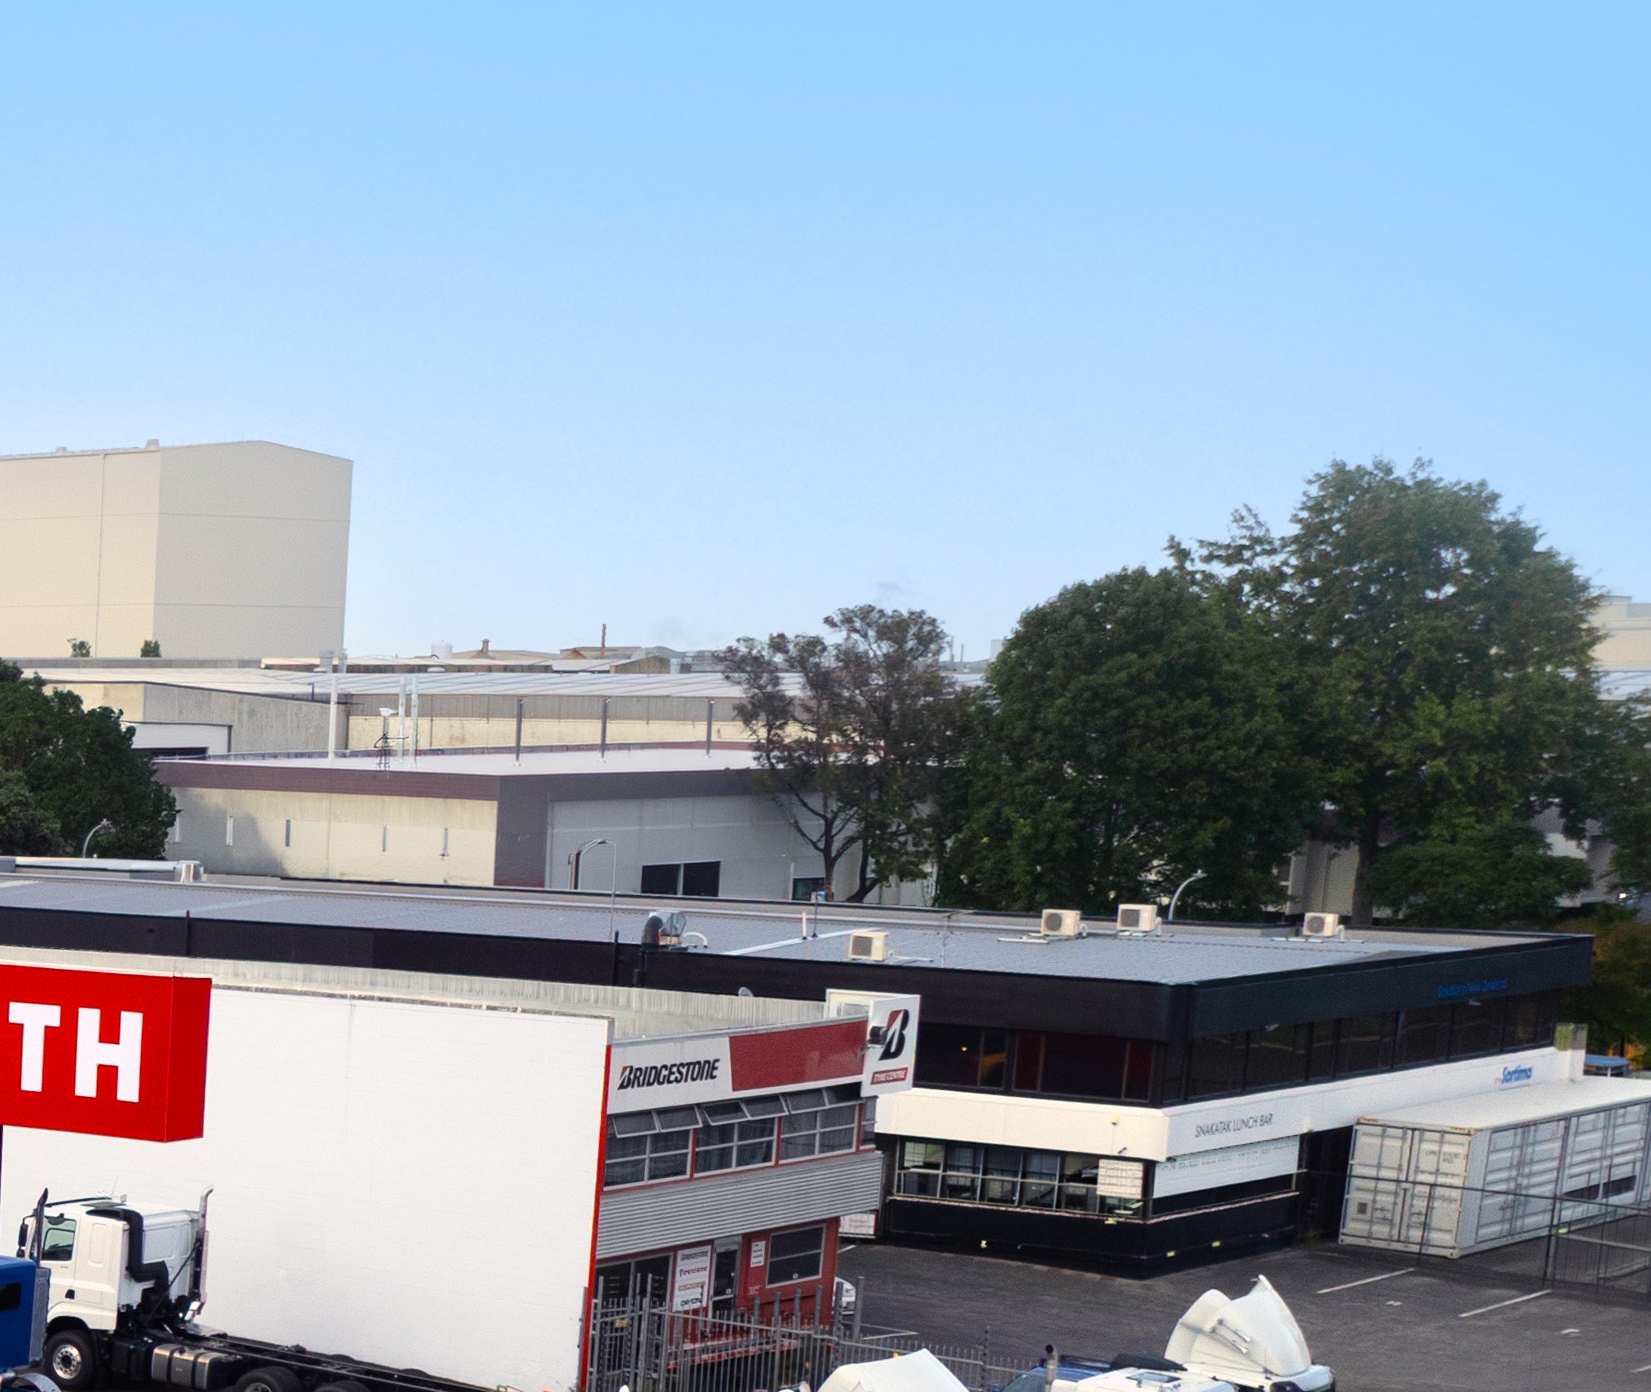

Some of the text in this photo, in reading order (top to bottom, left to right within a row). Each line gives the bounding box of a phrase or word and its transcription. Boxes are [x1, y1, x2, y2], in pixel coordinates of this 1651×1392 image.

[617, 1058, 721, 1090] BRIDGESTONE
[1233, 1116, 1258, 1132] LUNCH
[1260, 1113, 1273, 1126] BAR
